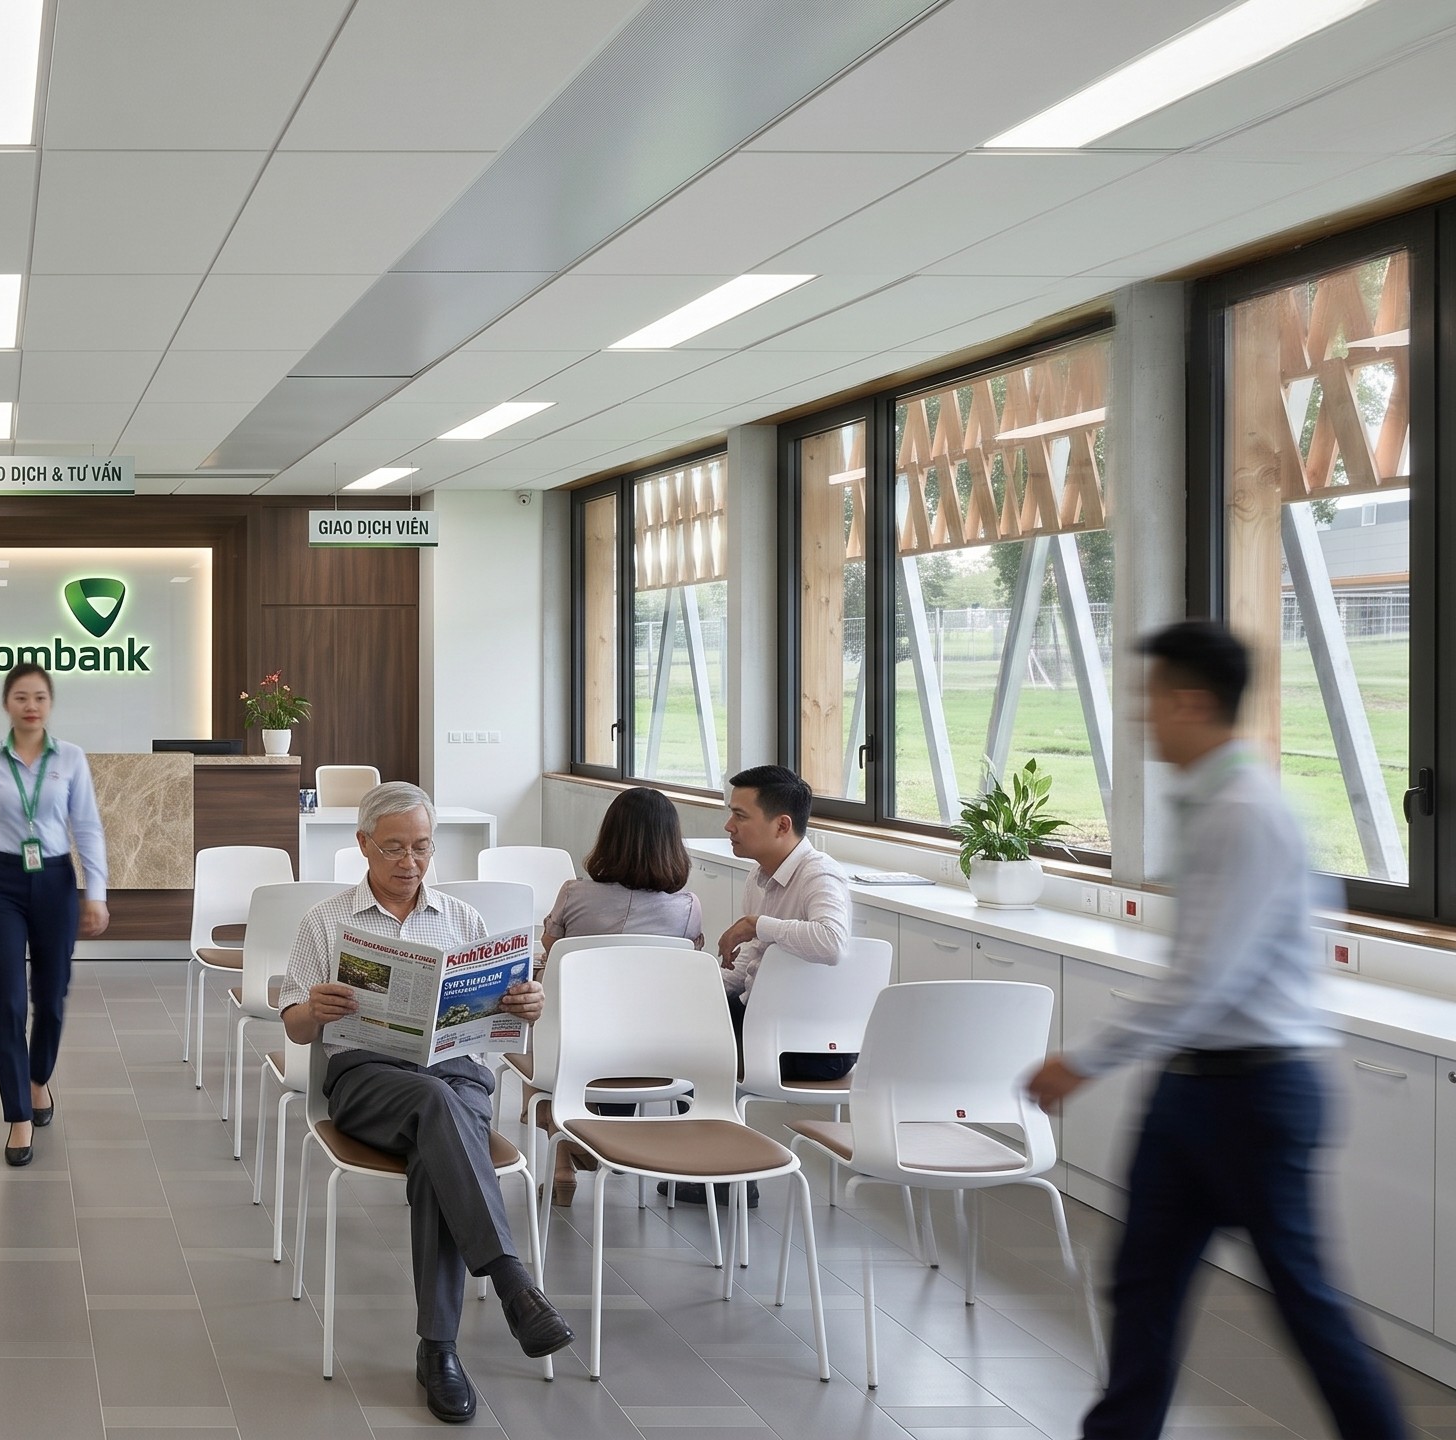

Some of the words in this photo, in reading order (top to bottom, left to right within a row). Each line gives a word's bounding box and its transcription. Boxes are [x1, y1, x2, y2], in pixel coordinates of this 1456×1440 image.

[11, 466, 47, 485] DỊCH
[51, 466, 63, 482] &
[67, 464, 88, 482] TƯ
[91, 460, 122, 482] VẤN
[318, 520, 352, 535] GIAO
[357, 520, 391, 538] DỊCH
[396, 517, 429, 535] VIÊN
